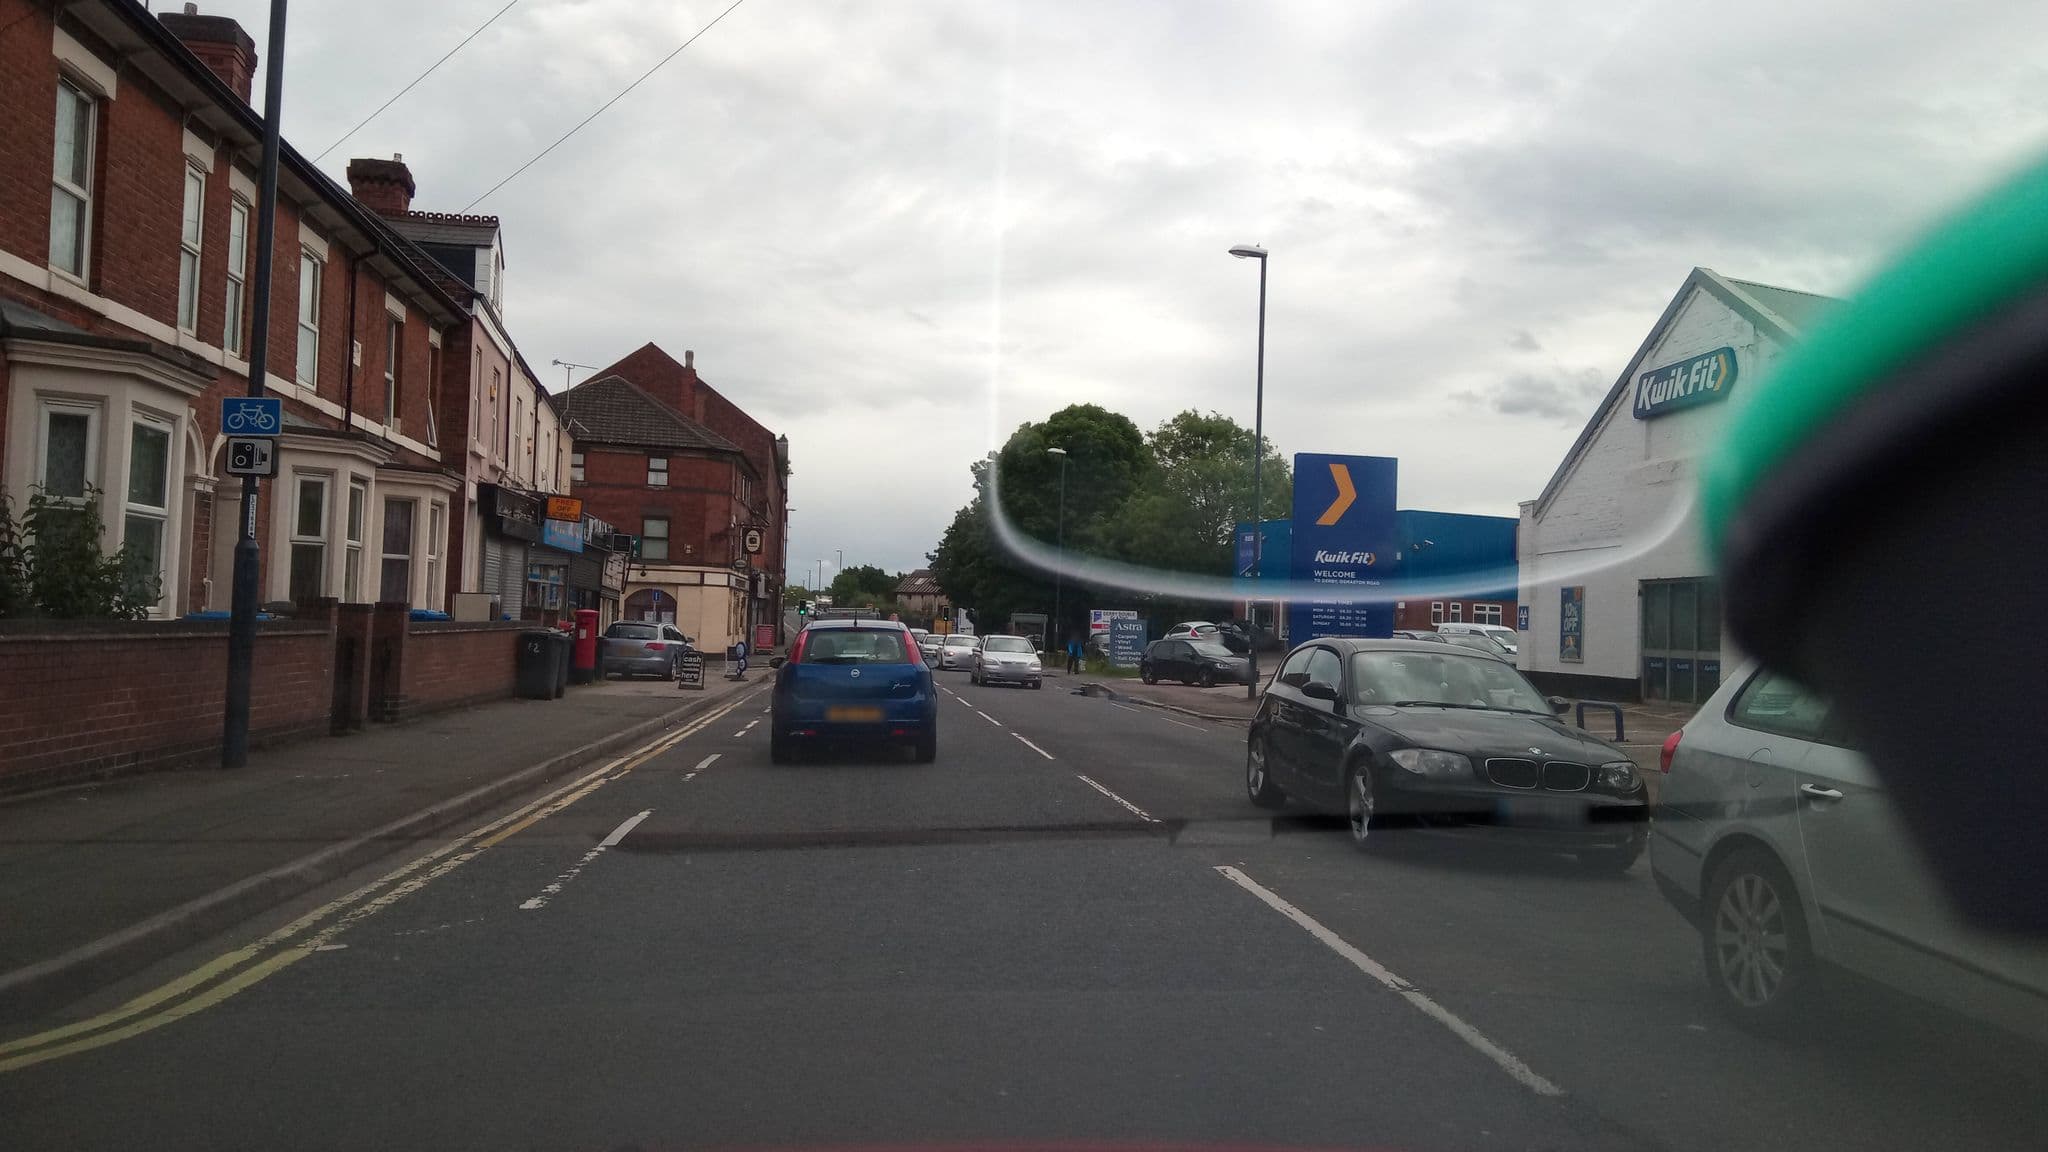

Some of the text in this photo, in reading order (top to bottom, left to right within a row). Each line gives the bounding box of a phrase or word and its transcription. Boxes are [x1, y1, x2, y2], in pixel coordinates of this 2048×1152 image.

[1314, 570, 1356, 578] WELCOME
[1115, 622, 1143, 631] Astra
[1563, 618, 1578, 631] OFF
[684, 655, 702, 663] cash
